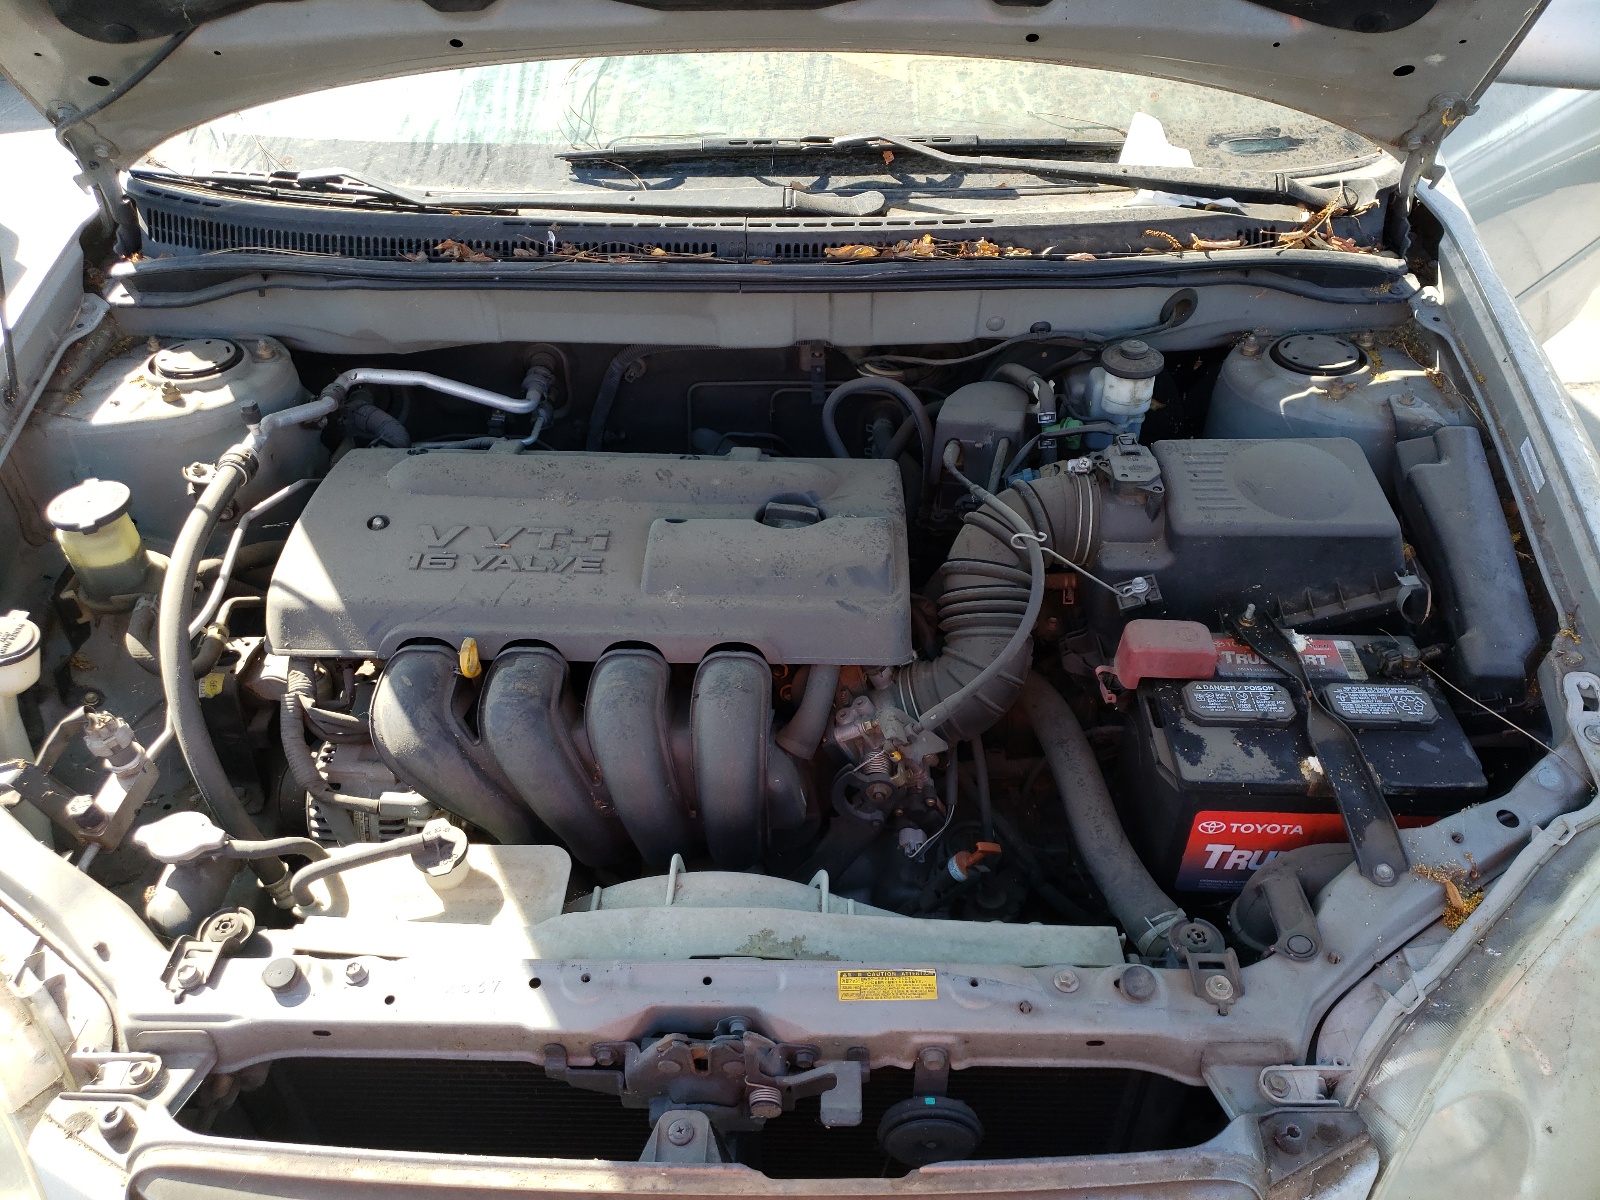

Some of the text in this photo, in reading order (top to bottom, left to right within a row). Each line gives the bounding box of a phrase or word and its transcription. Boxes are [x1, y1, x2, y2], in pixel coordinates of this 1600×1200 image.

[408, 552, 604, 574] 16 VALVE
[1229, 823, 1304, 835] TOYOTA
[1204, 843, 1282, 871] TRU
